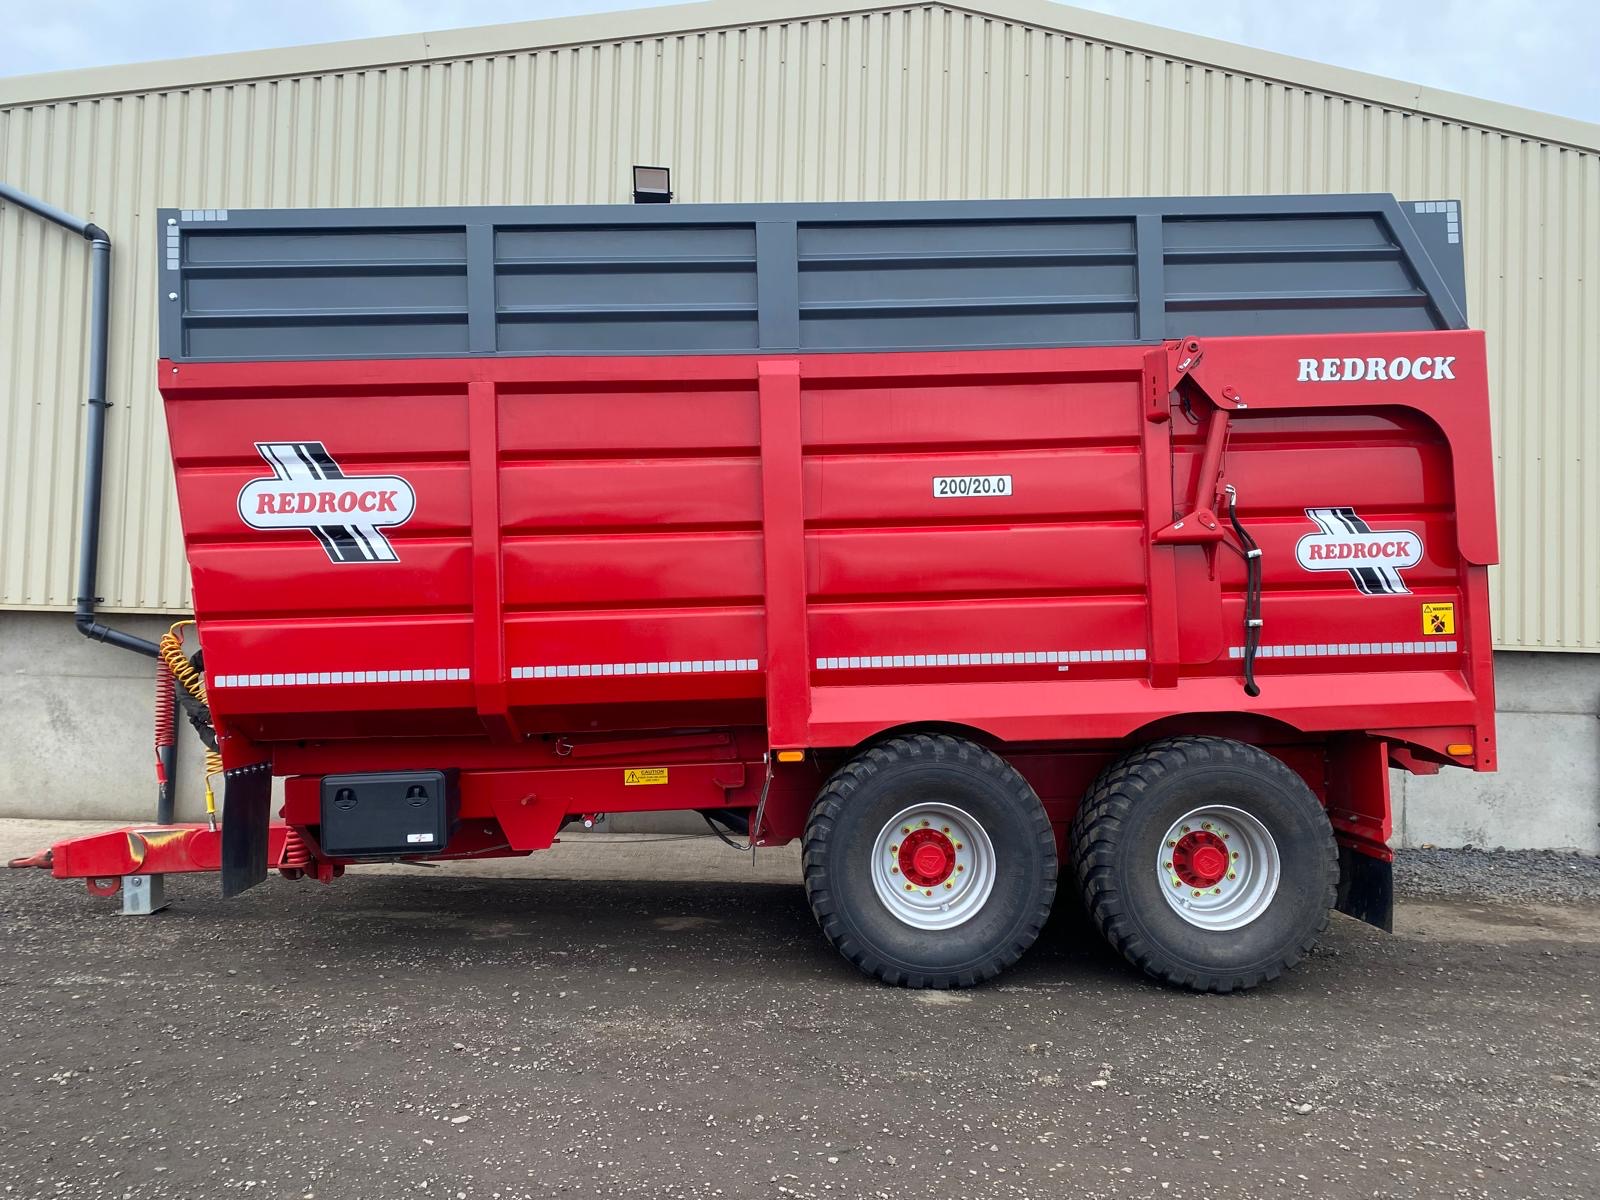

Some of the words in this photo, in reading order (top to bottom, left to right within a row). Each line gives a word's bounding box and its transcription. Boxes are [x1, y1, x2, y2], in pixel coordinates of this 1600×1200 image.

[1297, 356, 1456, 381] REDROCK
[940, 477, 1005, 495] 200/20.0
[255, 490, 398, 514] REDROCK
[1309, 541, 1410, 560] REDROCK
